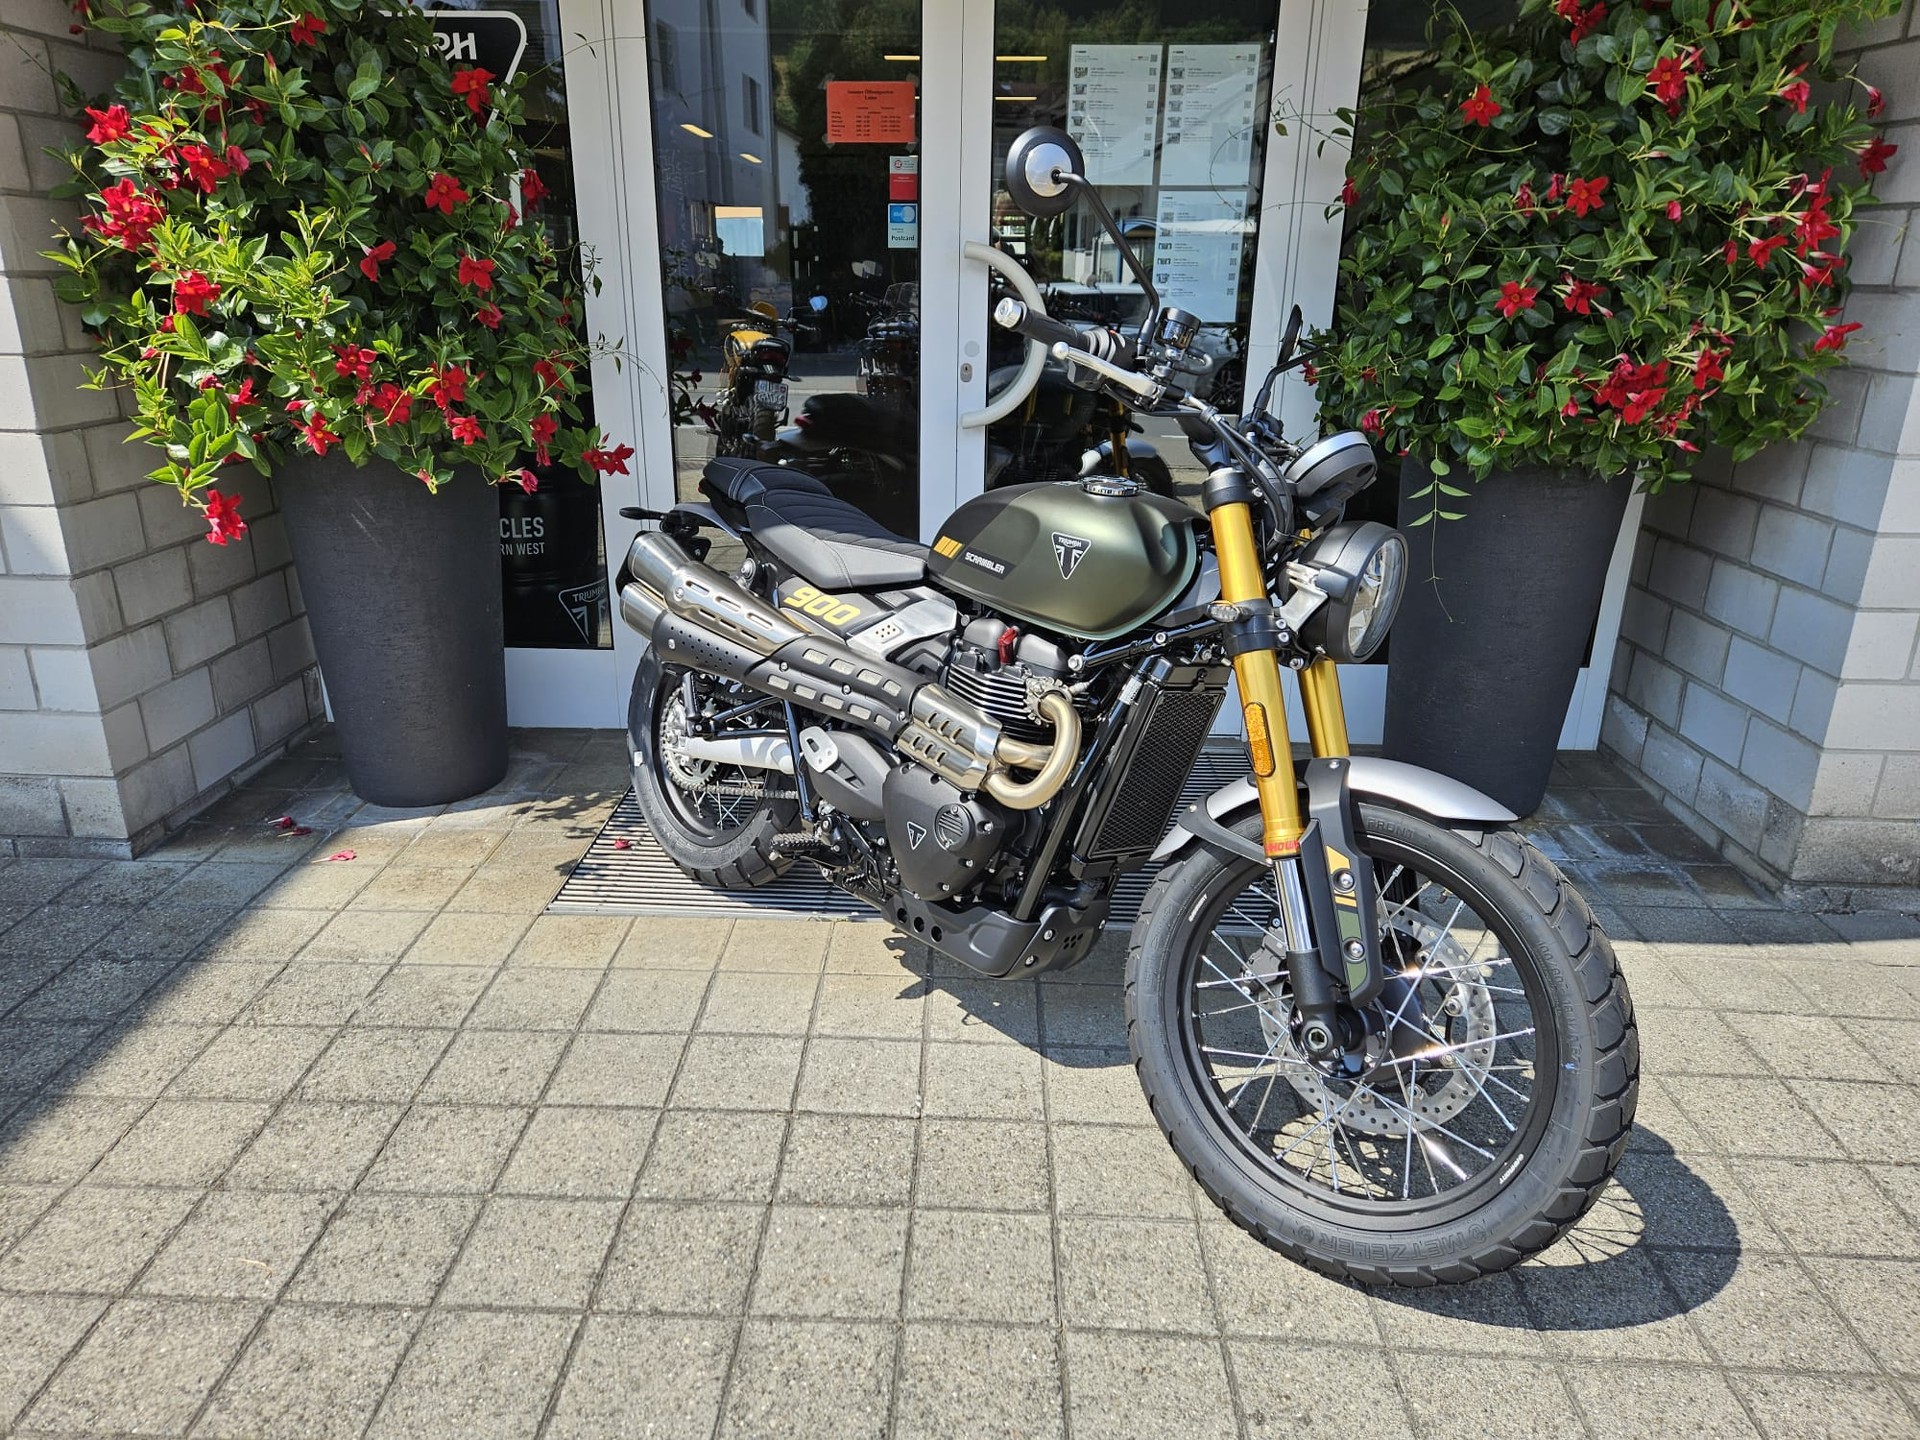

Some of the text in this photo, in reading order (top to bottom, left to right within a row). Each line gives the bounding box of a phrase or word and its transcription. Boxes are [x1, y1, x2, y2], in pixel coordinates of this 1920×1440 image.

[515, 541, 545, 556] WEST
[1058, 536, 1082, 548] TRIUMPH
[964, 551, 1005, 575] SCRAMBLER
[783, 586, 861, 626] 900
[1366, 816, 1416, 838] FRONT
[1318, 1233, 1471, 1262] METZELER
